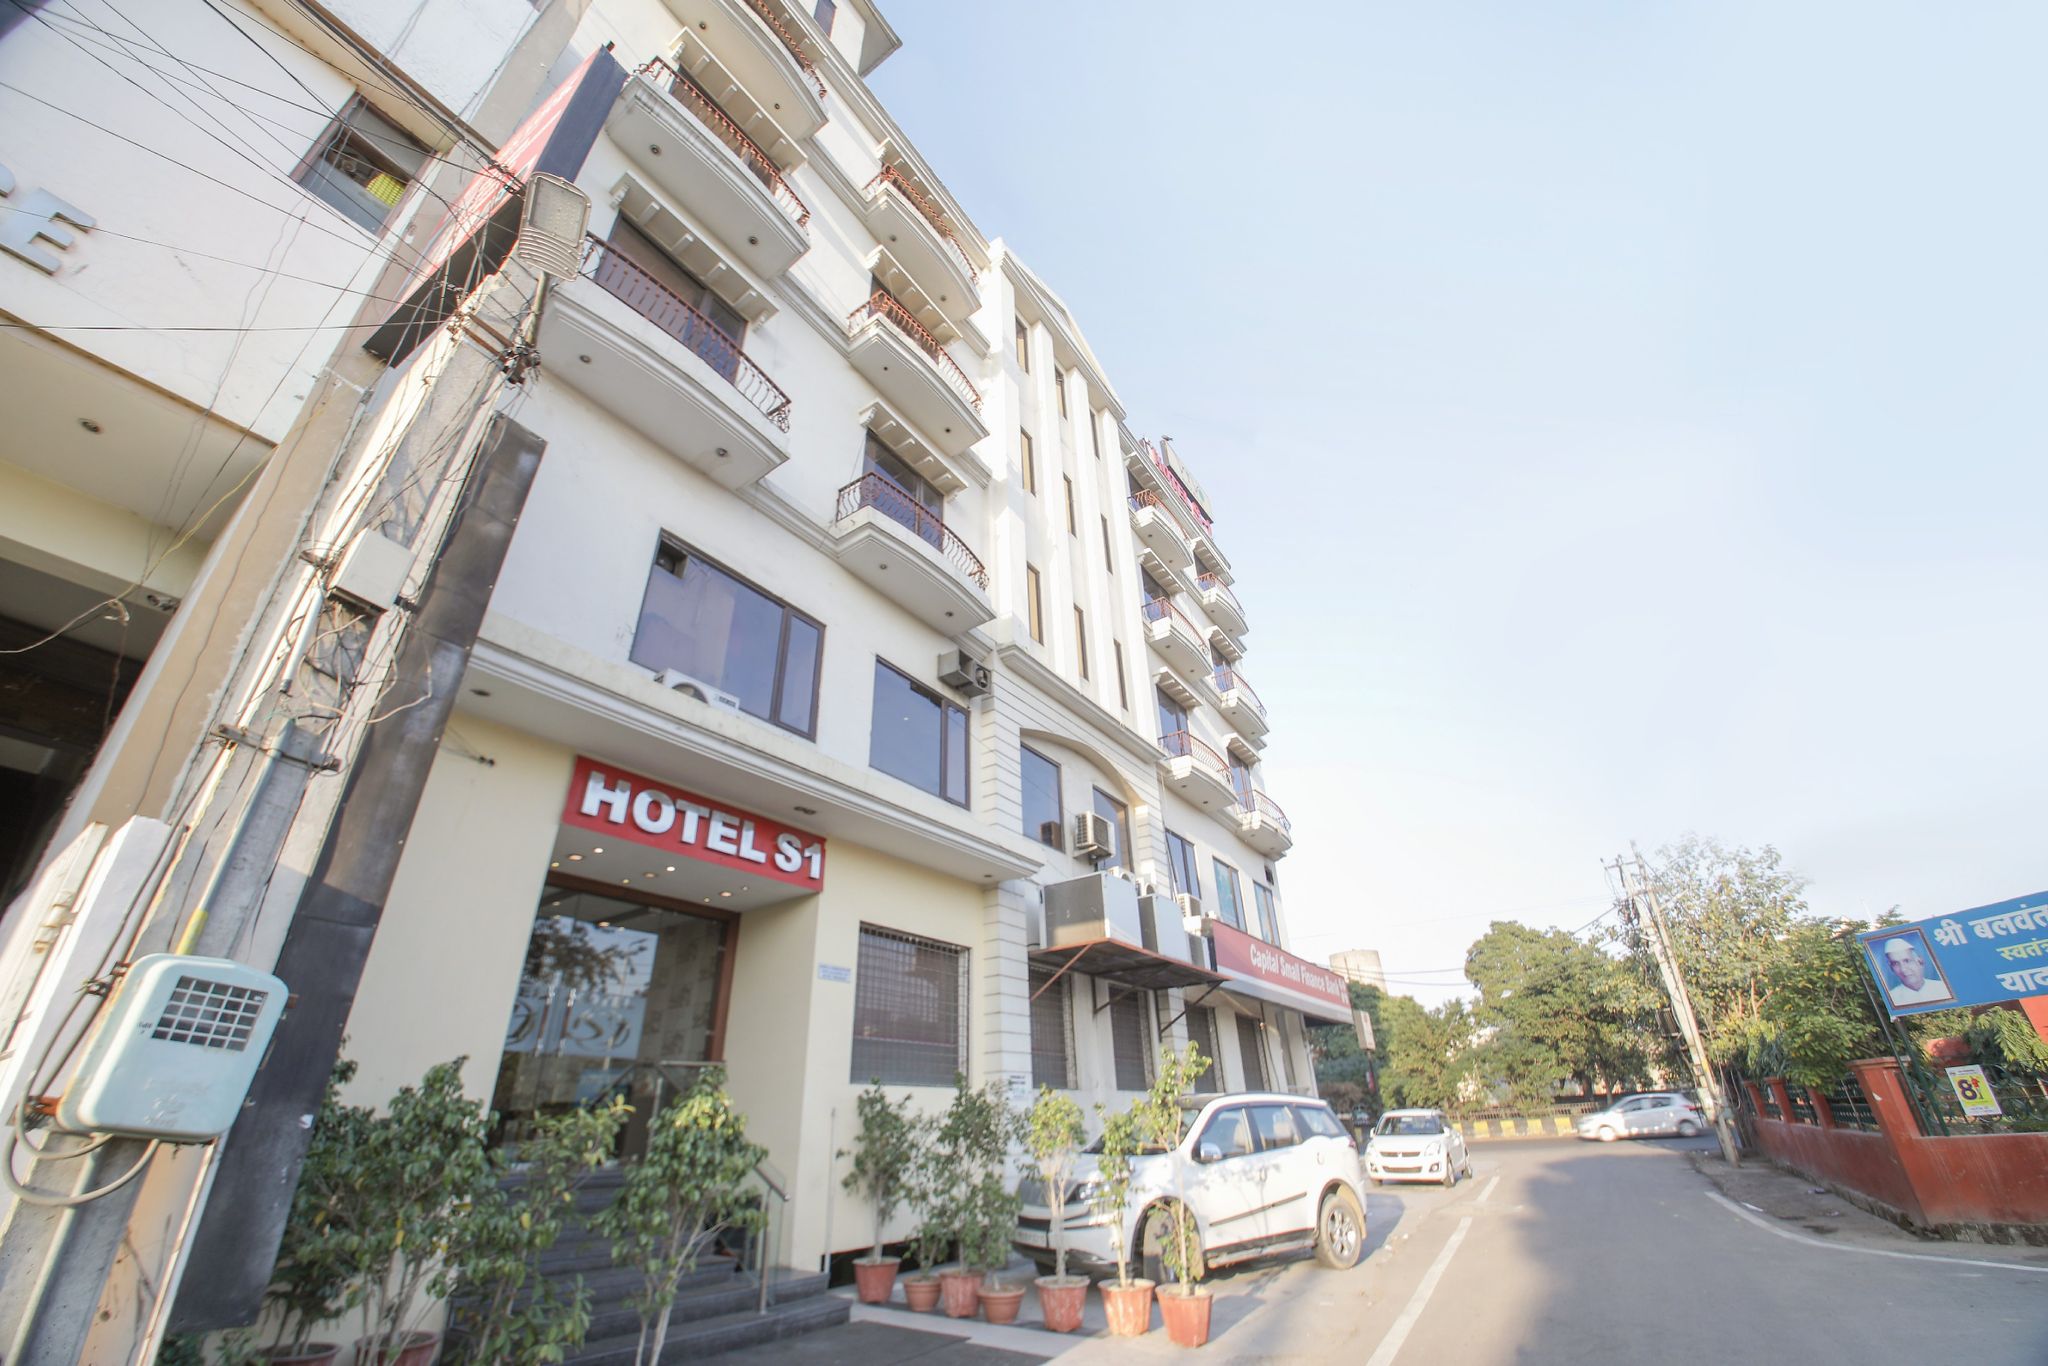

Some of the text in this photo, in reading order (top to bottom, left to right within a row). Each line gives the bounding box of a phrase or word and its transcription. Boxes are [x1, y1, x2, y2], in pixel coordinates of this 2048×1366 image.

[580, 770, 823, 880] HOTEL S1
[1933, 918, 1969, 947] श्री
[1250, 943, 1279, 975] Capital
